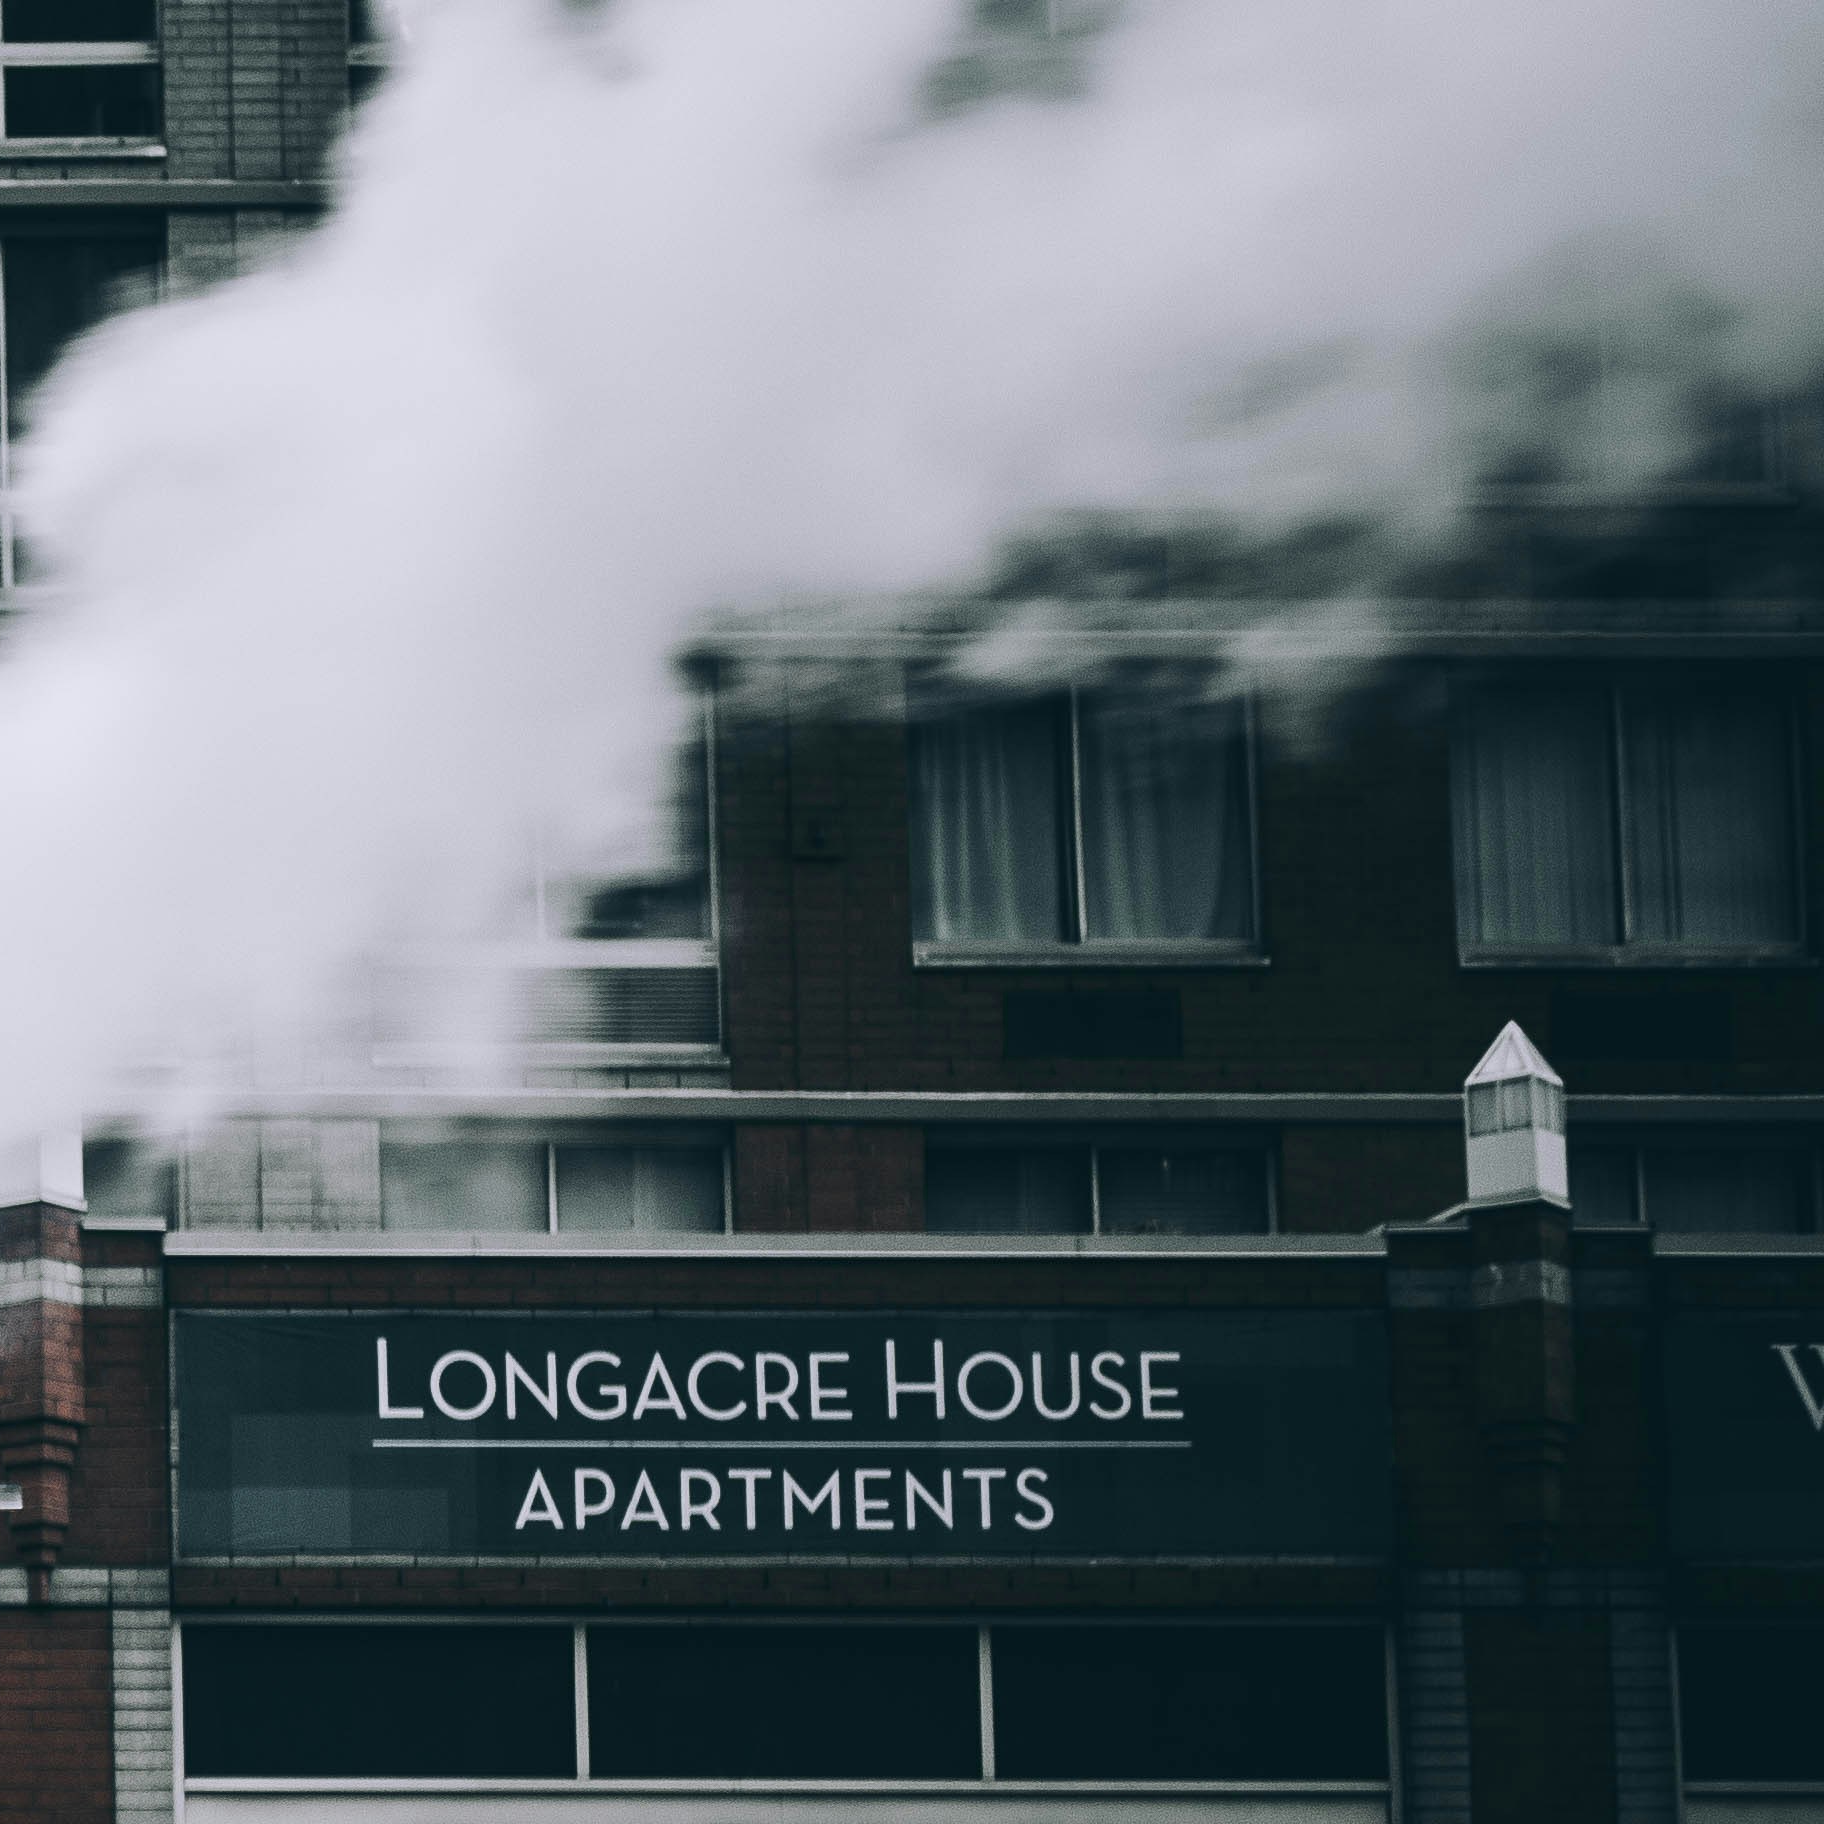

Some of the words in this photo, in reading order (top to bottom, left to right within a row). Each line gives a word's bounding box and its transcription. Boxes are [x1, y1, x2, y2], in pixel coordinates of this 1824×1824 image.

[375, 1337, 854, 1422] LONGACRE
[884, 1338, 1185, 1422] HOUSE
[514, 1467, 1055, 1532] APARTMENTS
